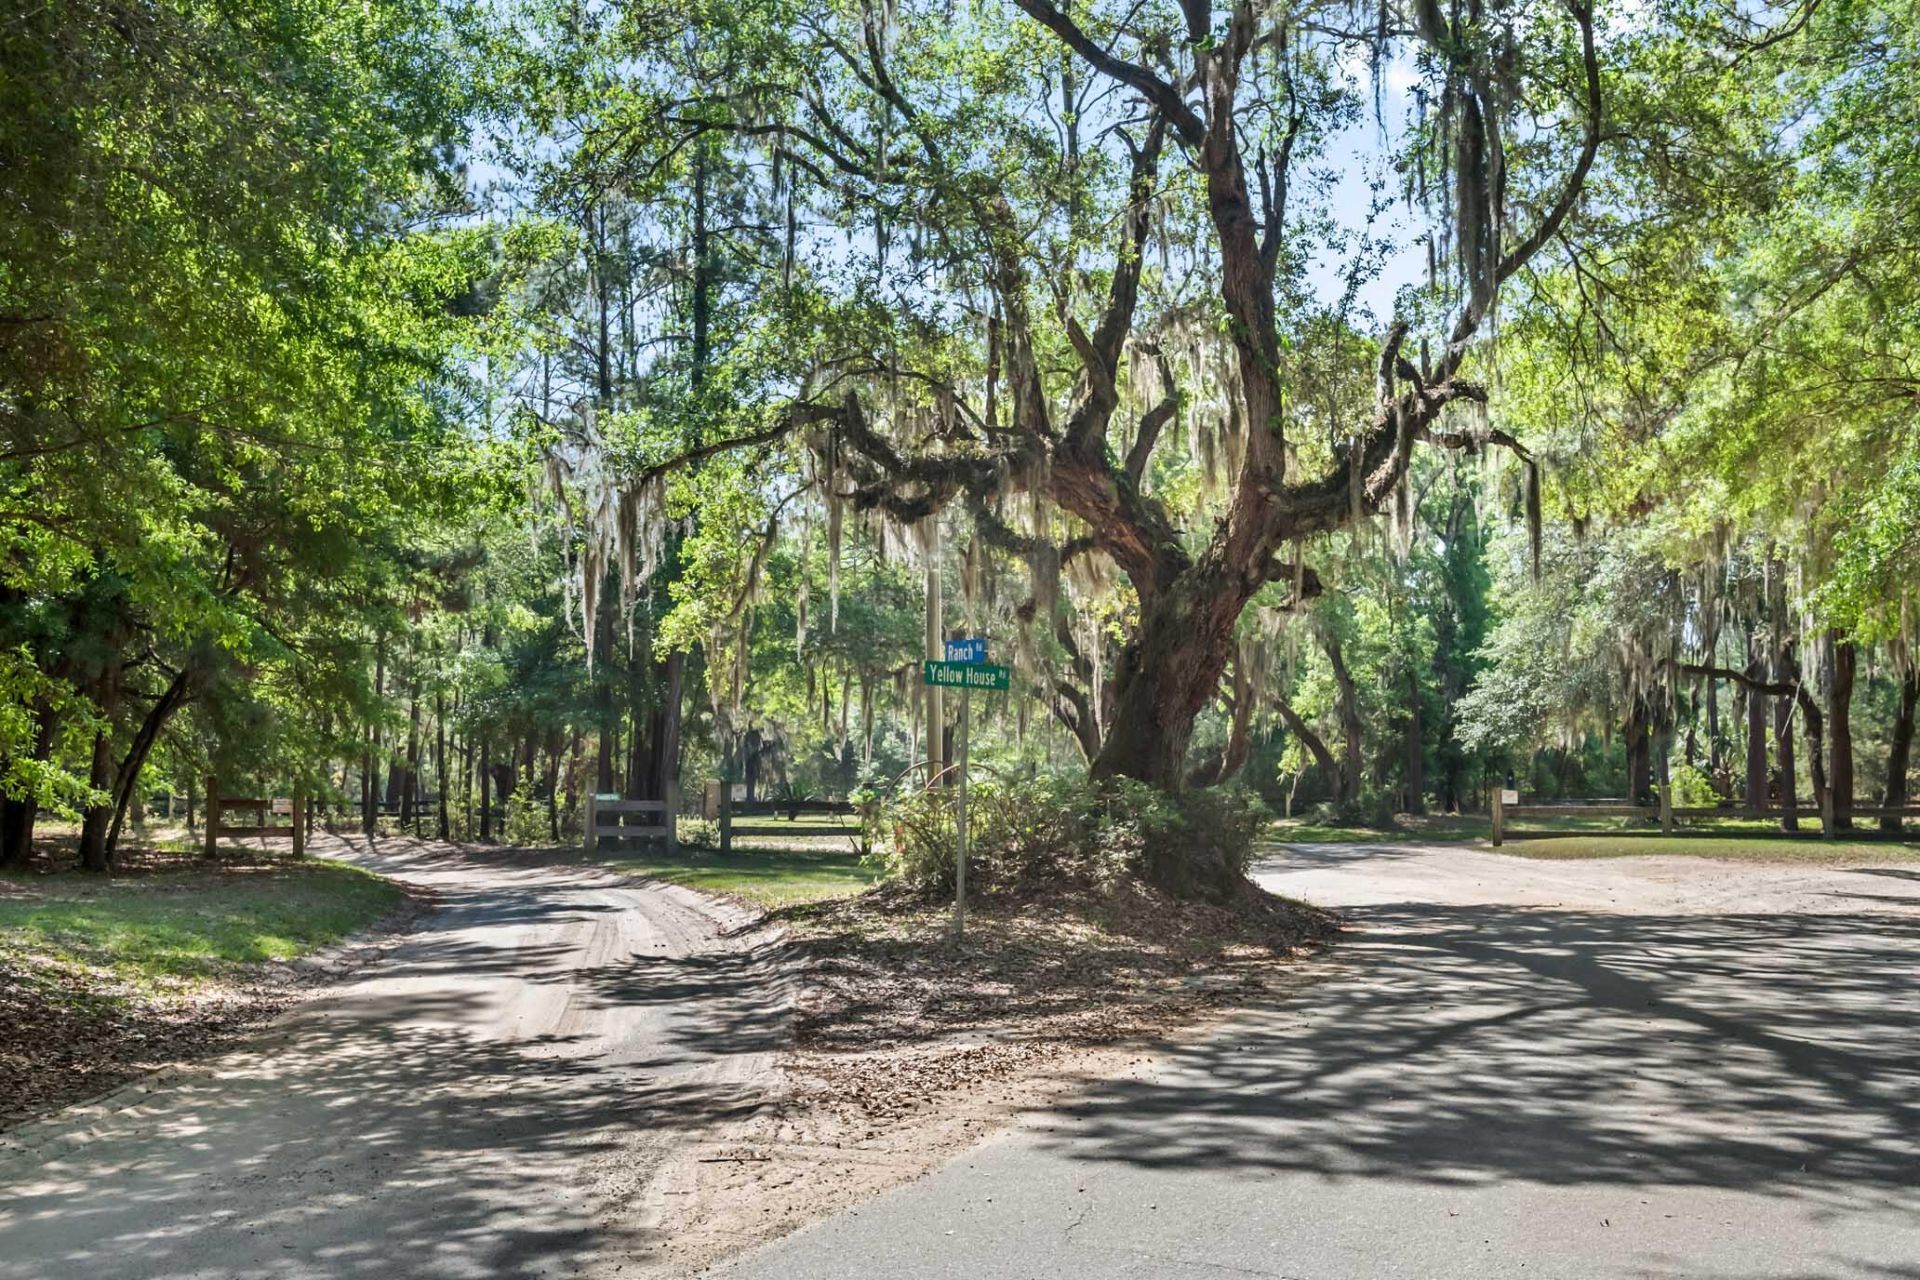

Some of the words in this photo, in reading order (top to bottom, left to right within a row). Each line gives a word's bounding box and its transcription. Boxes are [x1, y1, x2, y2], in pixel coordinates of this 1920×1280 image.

[948, 644, 973, 661] Ranch
[930, 664, 963, 683] Yellow
[966, 667, 996, 686] House
